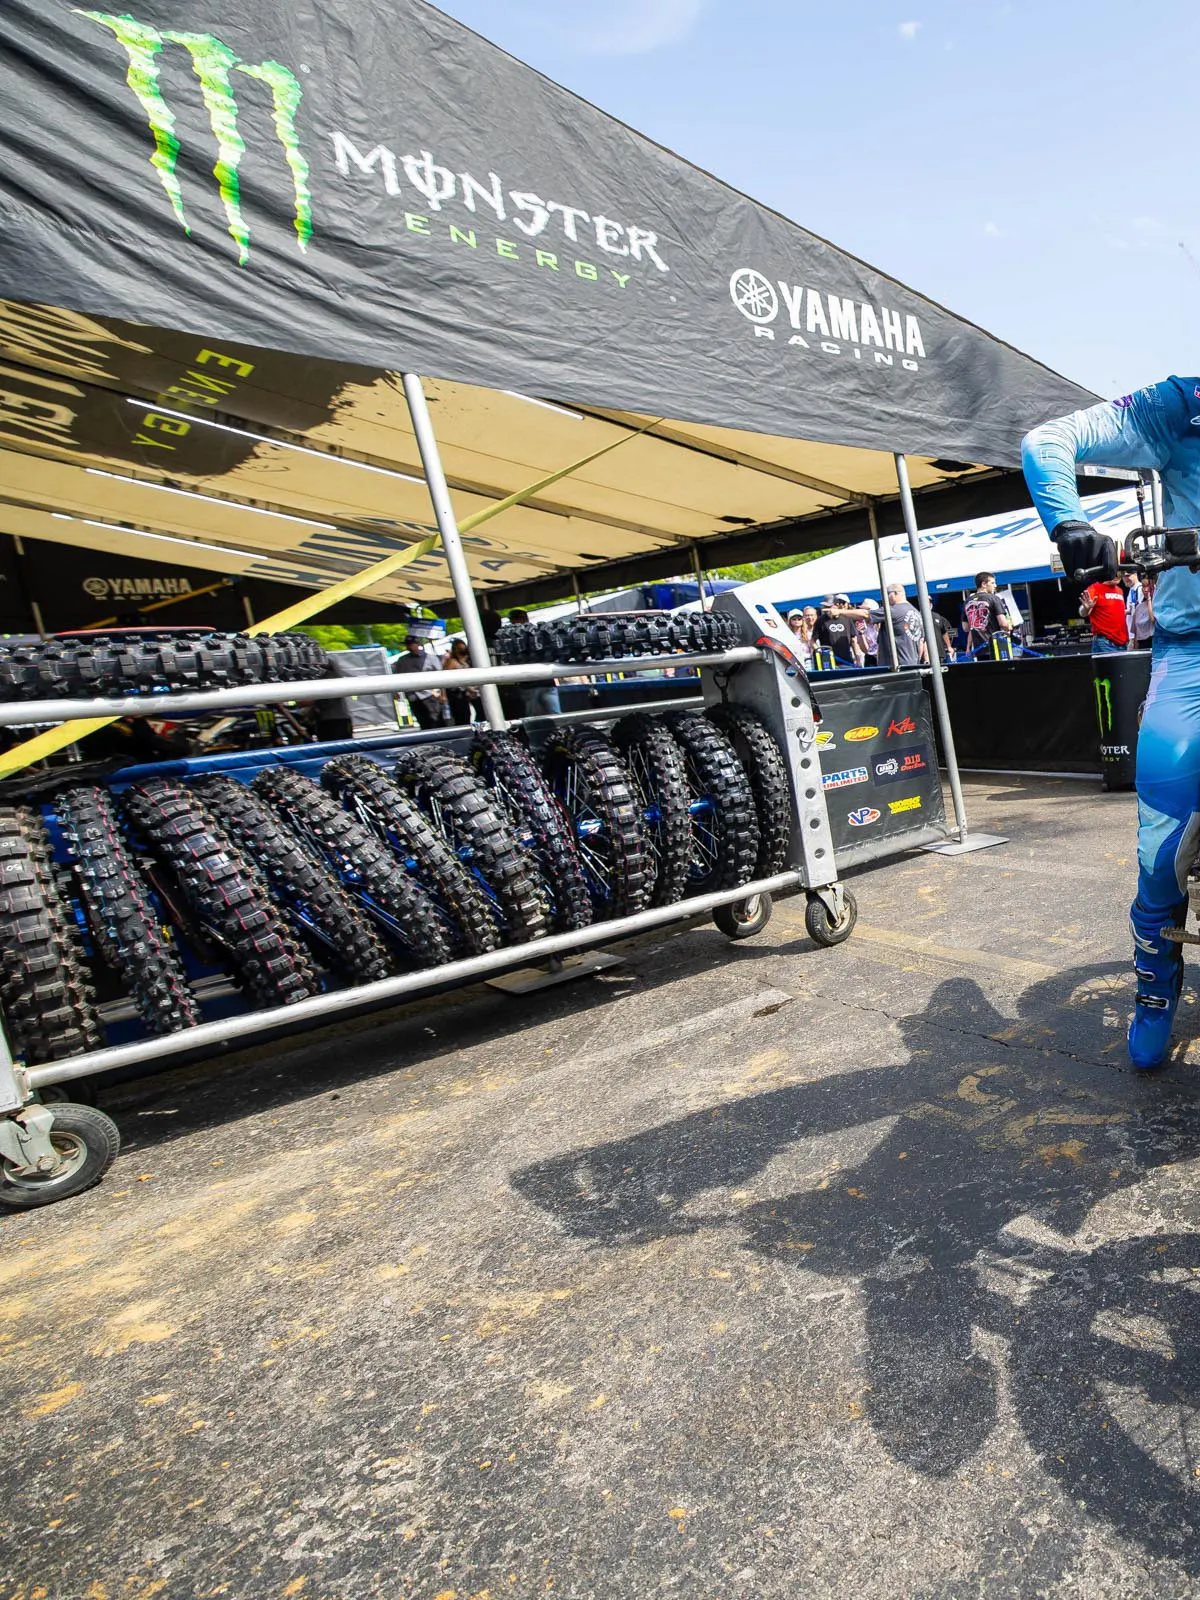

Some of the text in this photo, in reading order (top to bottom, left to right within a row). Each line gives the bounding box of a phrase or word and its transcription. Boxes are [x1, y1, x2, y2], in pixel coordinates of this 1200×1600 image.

[327, 131, 670, 272] MONSTER
[404, 211, 631, 288] ENERGY
[777, 281, 926, 358] YAMAHA
[754, 325, 919, 371] RACING
[108, 578, 193, 595] YAMAHA
[821, 767, 867, 784] PARTS
[823, 776, 868, 789] UNLIMITED
